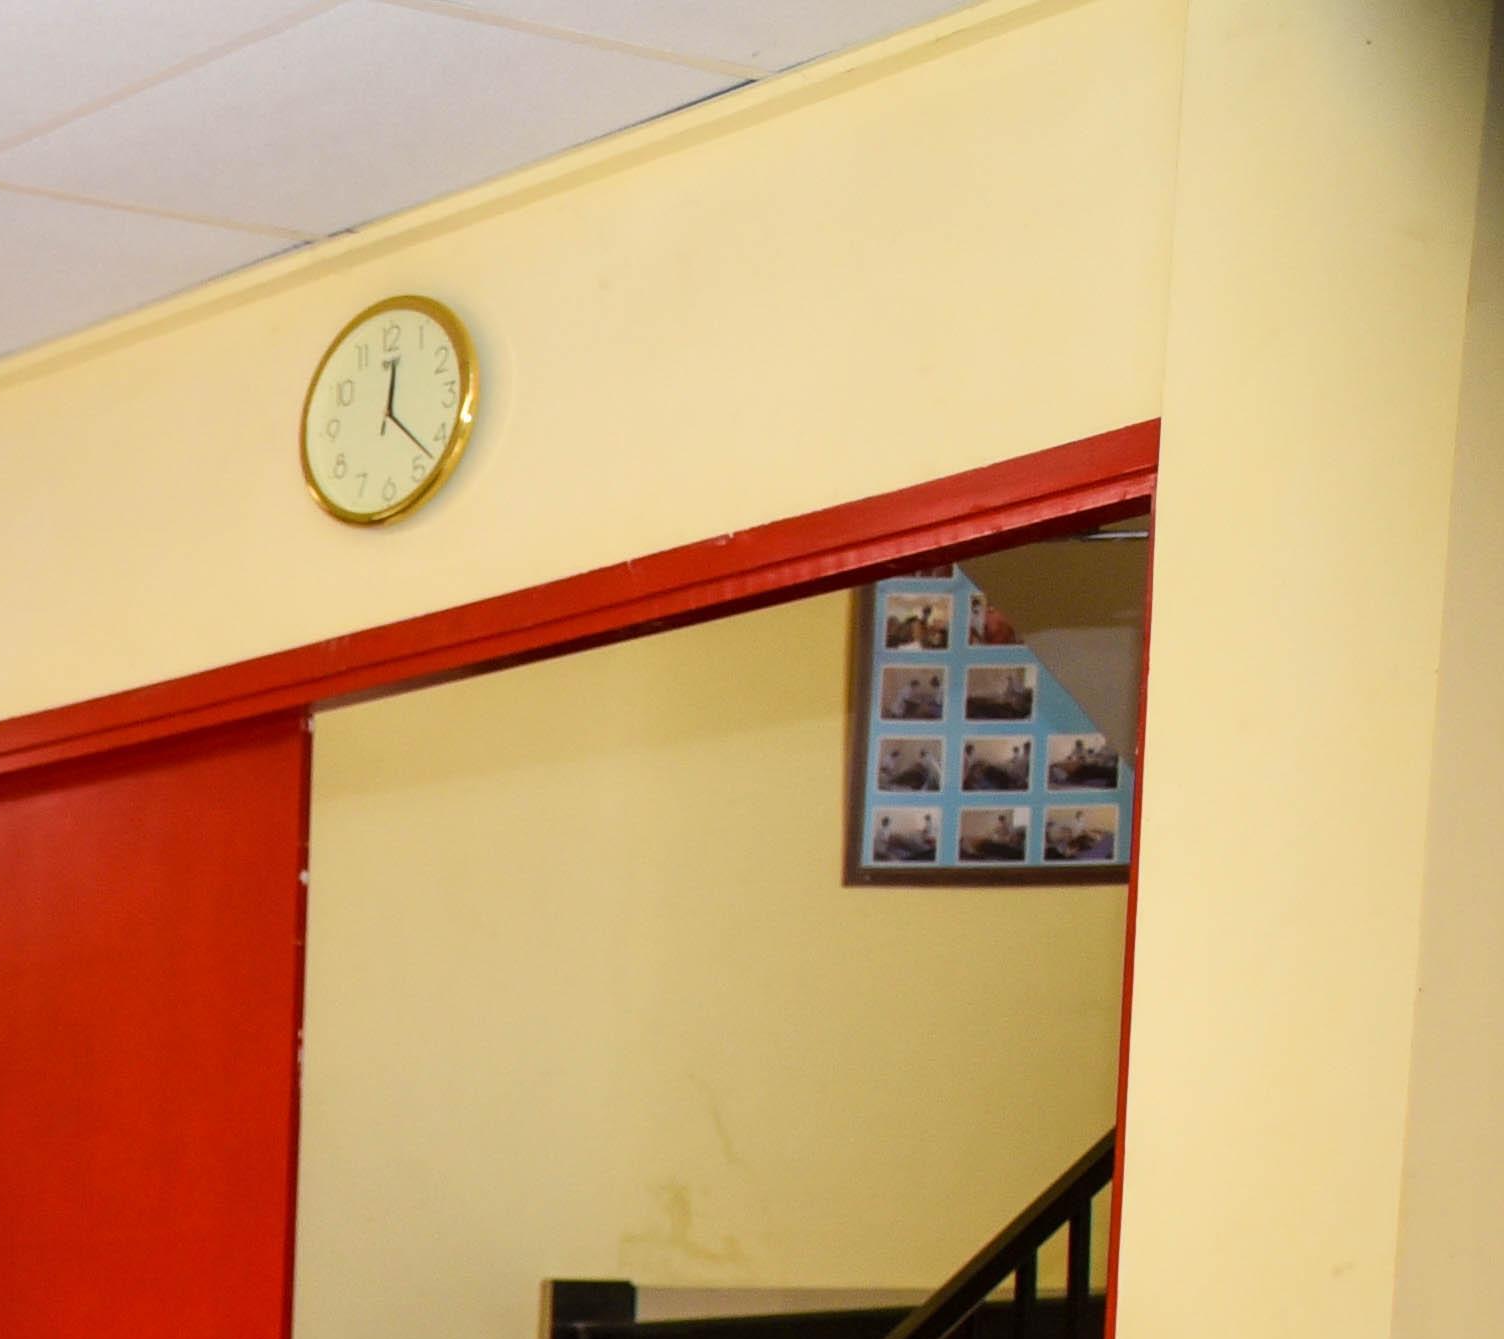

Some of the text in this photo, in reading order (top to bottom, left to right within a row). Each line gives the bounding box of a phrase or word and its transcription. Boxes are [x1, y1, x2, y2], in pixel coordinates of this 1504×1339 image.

[382, 324, 402, 352] 12
[355, 344, 369, 370] 11
[434, 346, 450, 374] 2
[336, 379, 354, 407] 10
[441, 380, 457, 408] 3
[326, 419, 340, 442] 9
[433, 422, 447, 443] 4
[331, 453, 347, 479] 8
[411, 456, 426, 482] 5
[356, 473, 368, 498] 7
[382, 478, 397, 502] 6
